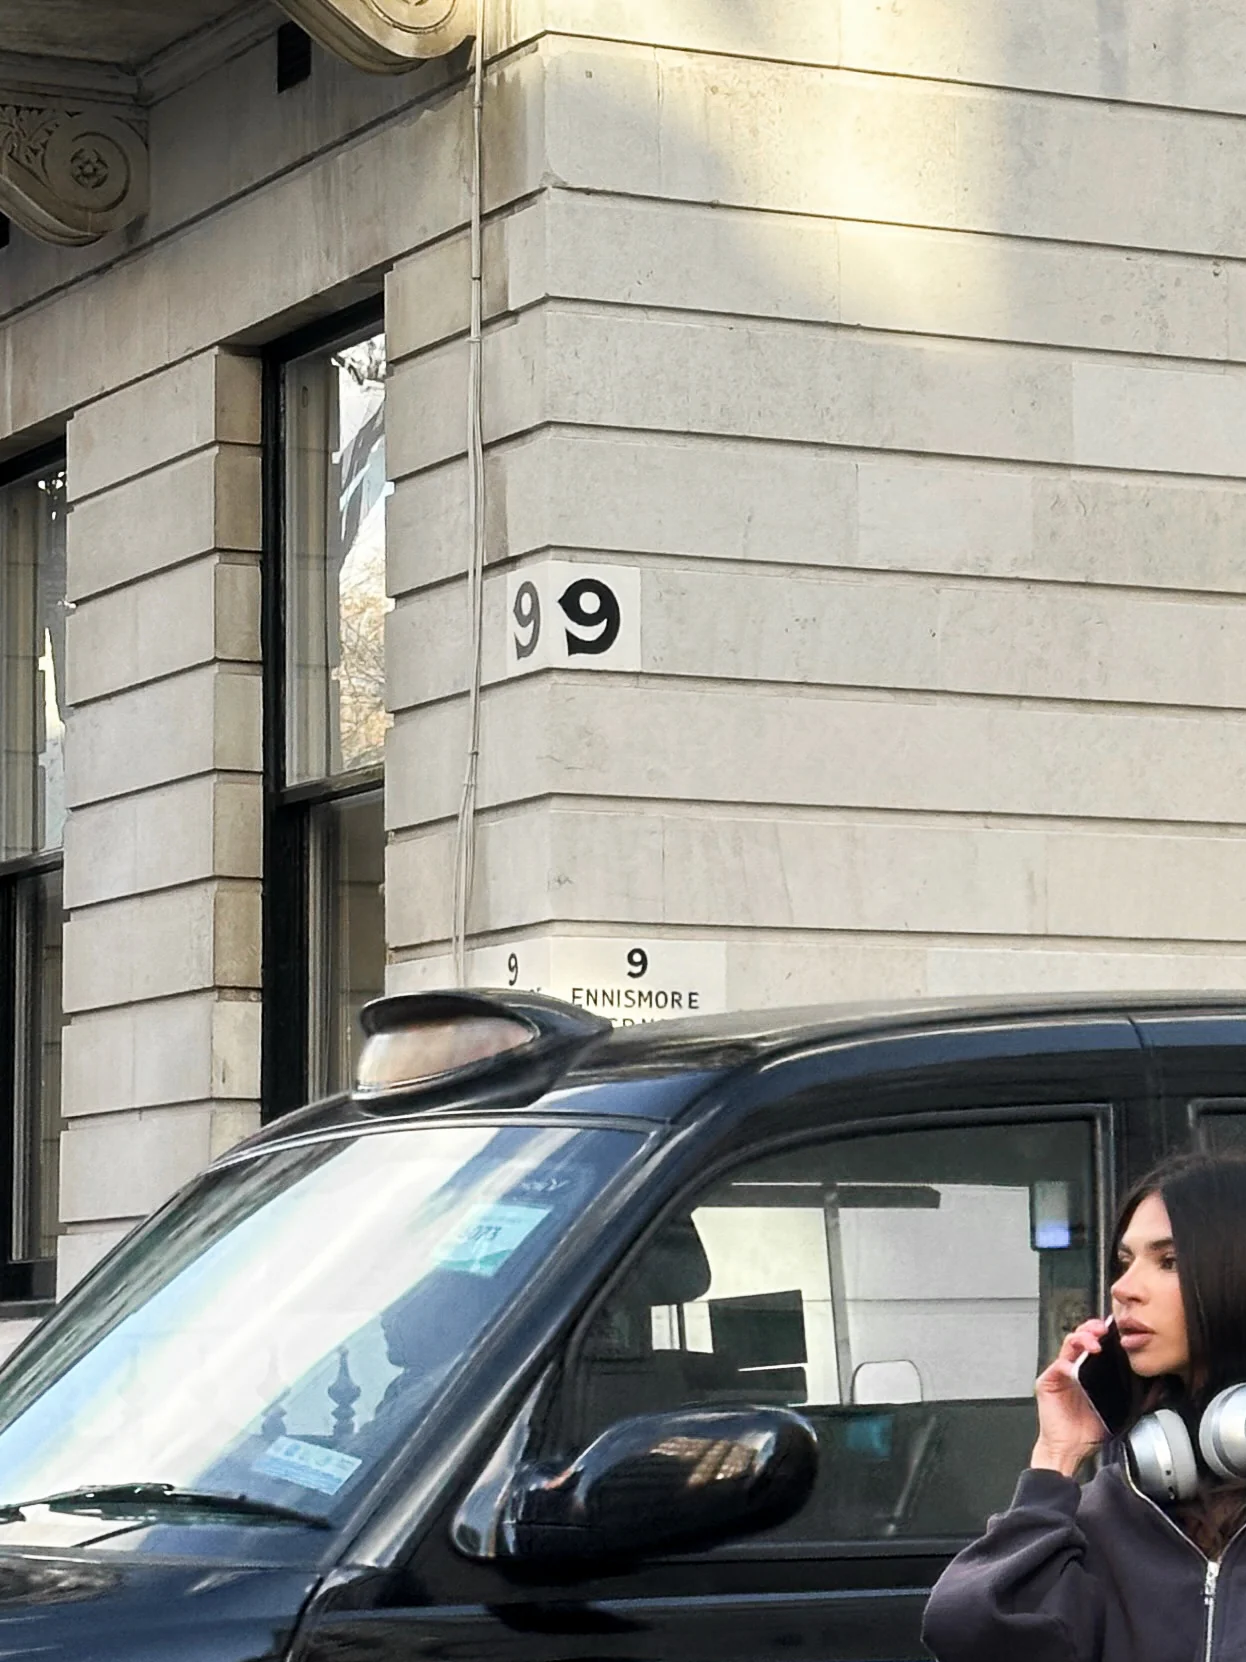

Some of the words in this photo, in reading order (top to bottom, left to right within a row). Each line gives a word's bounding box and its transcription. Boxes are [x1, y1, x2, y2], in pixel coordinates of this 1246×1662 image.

[513, 580, 541, 660] 9
[557, 577, 621, 656] 9
[507, 952, 519, 986] 9
[626, 948, 648, 979] 9
[571, 987, 700, 1009] ENNISMORE
